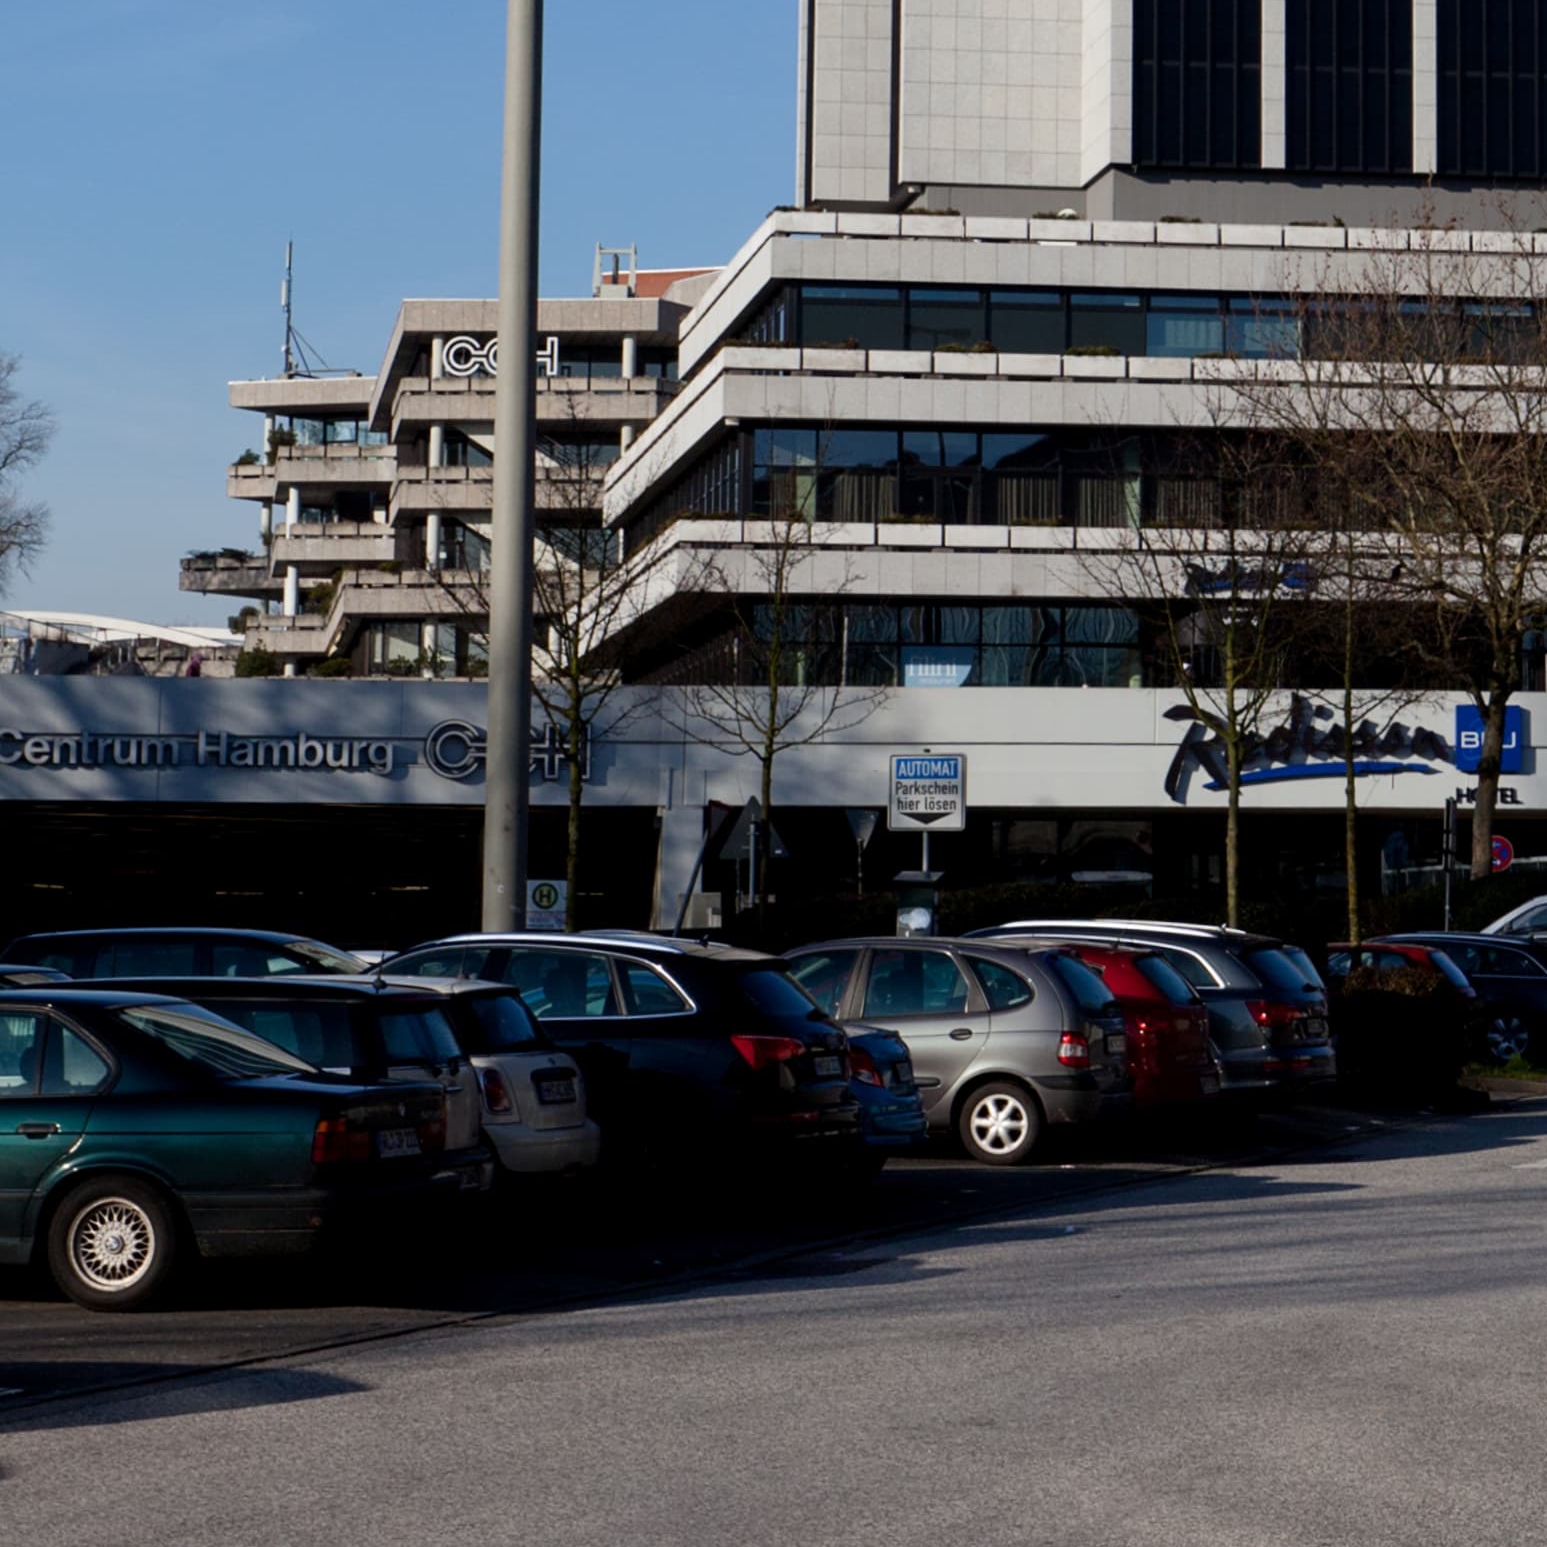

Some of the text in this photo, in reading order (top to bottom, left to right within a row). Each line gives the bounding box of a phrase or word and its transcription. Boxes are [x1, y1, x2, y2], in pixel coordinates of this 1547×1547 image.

[0, 718, 591, 780] Centrum Hamburg CH
[898, 760, 956, 777] AUTOMAT
[895, 781, 958, 795] Parkschein
[897, 796, 957, 811] hier lösen
